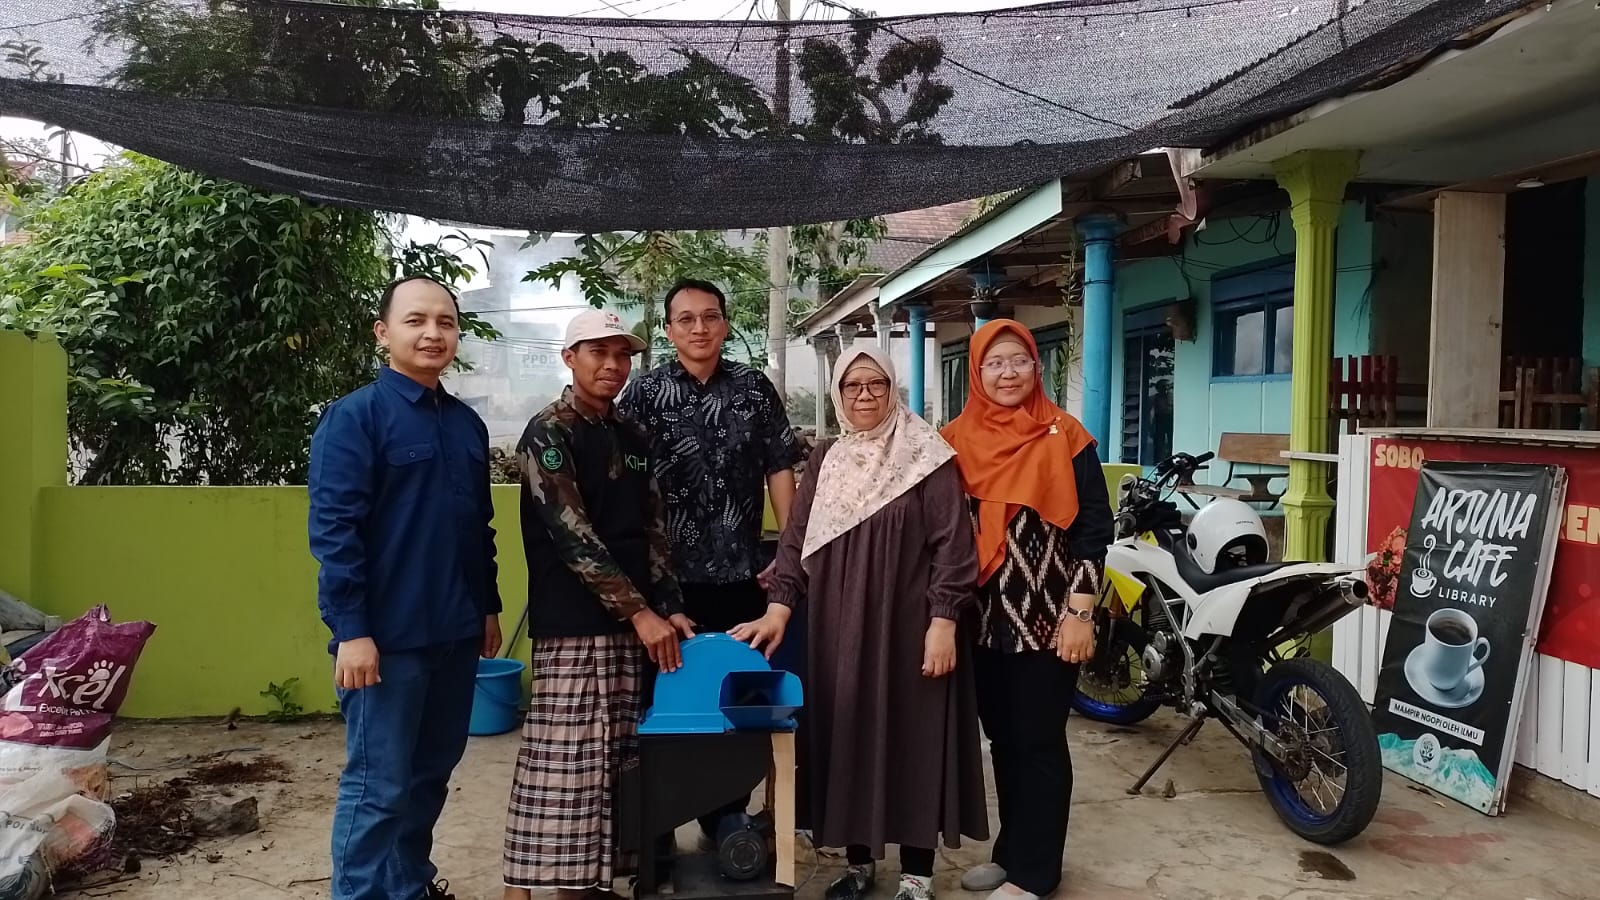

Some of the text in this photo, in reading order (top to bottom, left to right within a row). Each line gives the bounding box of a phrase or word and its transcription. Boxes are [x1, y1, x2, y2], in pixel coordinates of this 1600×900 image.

[624, 453, 648, 472] KTH
[1374, 444, 1424, 470] SOBO
[1421, 486, 1538, 545] ARJUNA
[1443, 539, 1518, 588] CAFE
[1438, 586, 1497, 608] LIBRARY
[1393, 703, 1479, 740] MAMPIR NGOPI OLEH ILMU
